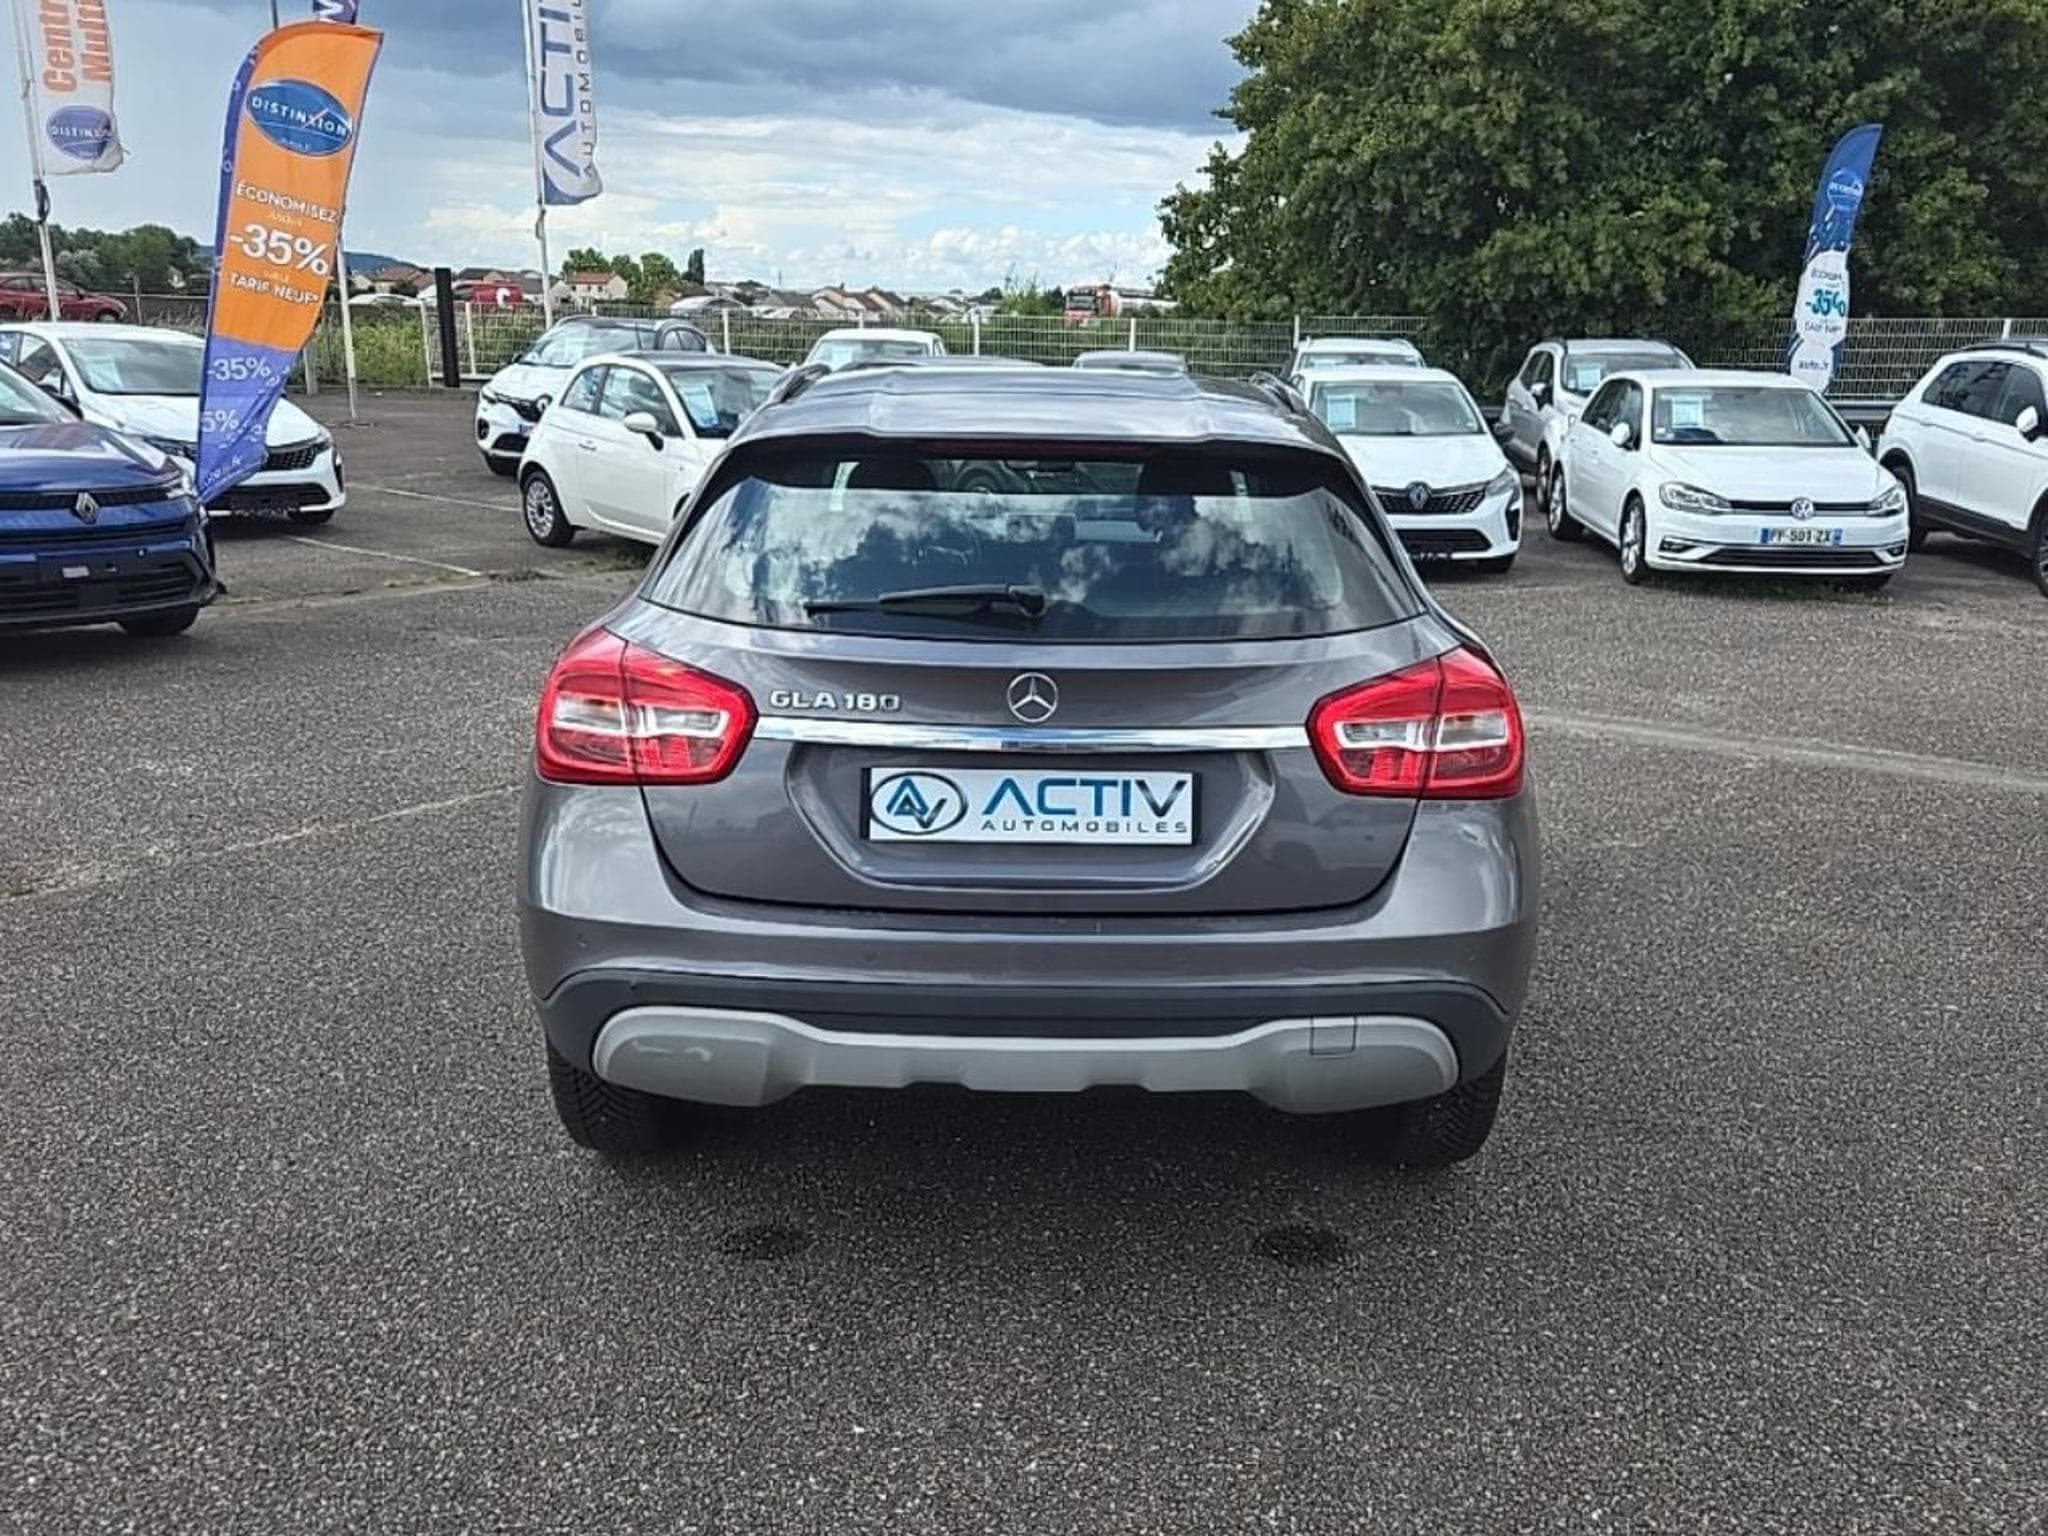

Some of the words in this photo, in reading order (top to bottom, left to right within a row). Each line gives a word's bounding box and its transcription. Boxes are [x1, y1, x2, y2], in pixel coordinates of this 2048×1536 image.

[251, 95, 348, 135] DISTINXION
[229, 223, 330, 276] -35%
[230, 273, 270, 293] TARIF
[770, 690, 837, 709] GLA
[843, 692, 900, 711] 180
[981, 777, 1188, 818] ACTIV
[980, 819, 1188, 834] AUTOMOBILES
